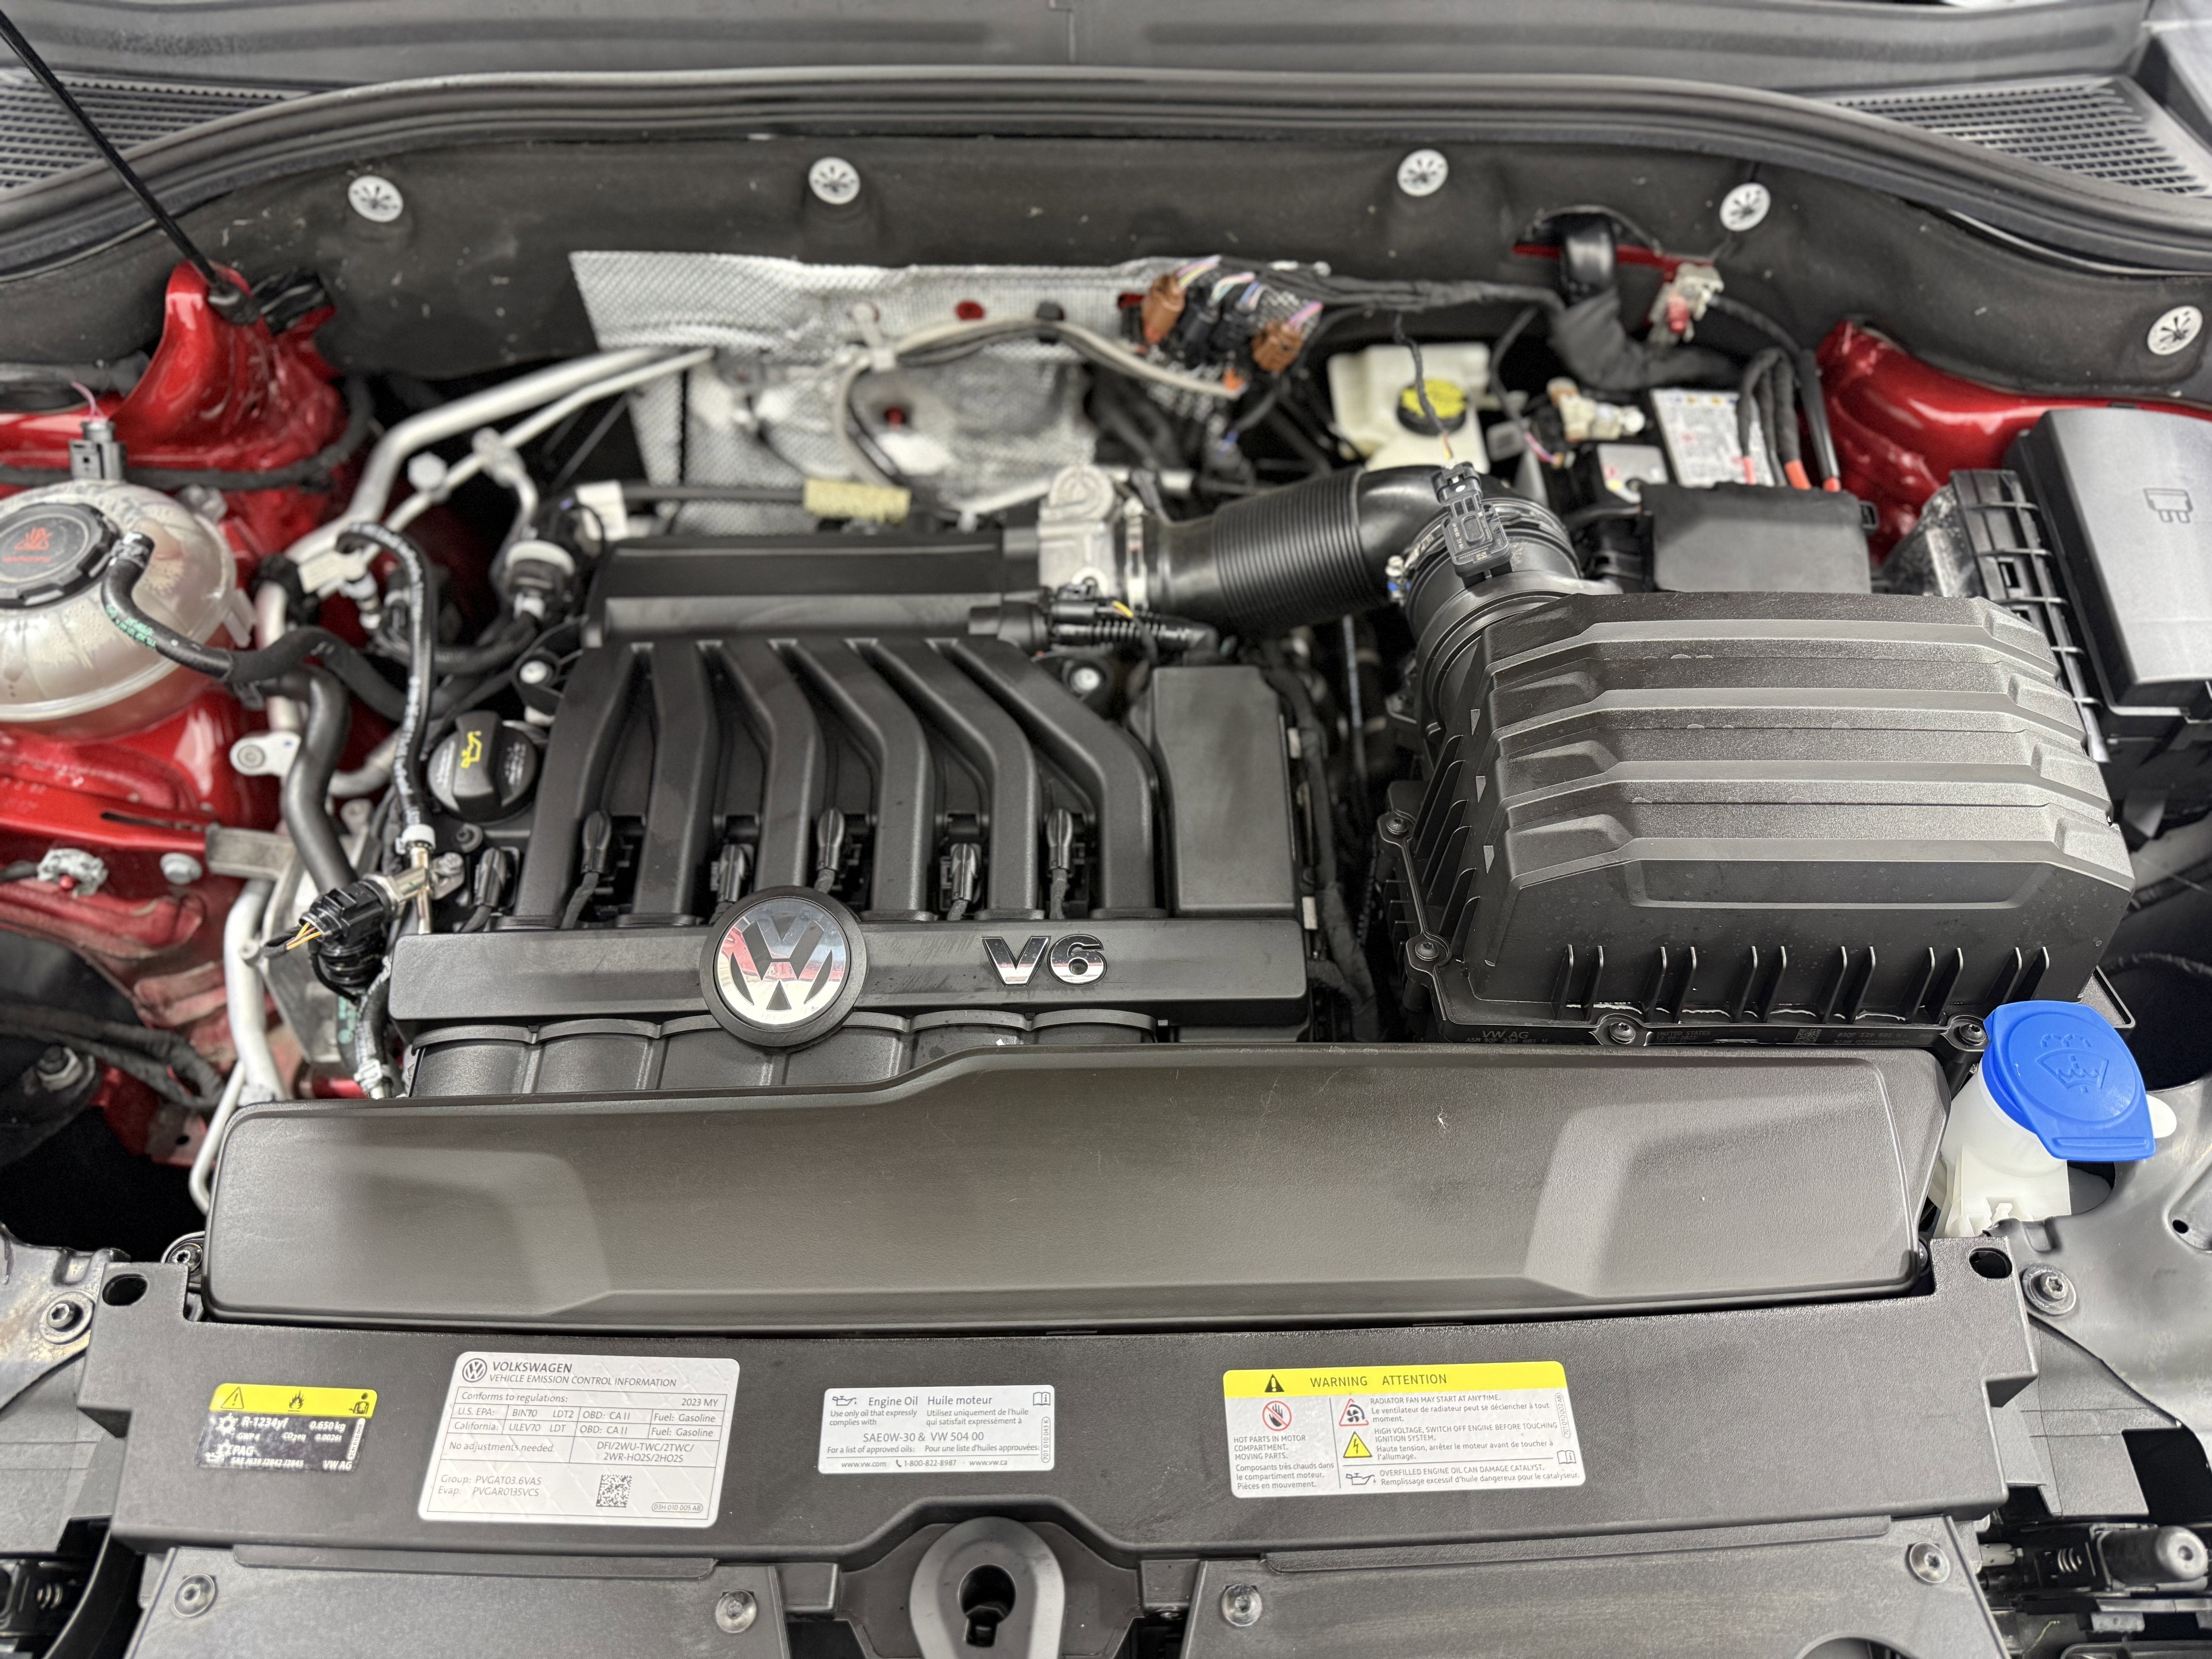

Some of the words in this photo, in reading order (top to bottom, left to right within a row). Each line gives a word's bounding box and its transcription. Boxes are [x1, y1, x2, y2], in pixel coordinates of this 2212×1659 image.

[981, 934, 1108, 988] V6
[493, 1362, 572, 1373] VOLKSWAGEN
[527, 1375, 569, 1383] EMISSION
[572, 1376, 611, 1385] CONTROL
[615, 1377, 676, 1387] INFORMATION
[1310, 1376, 1368, 1387] WARNING
[1382, 1374, 1447, 1385] ATTENTION
[462, 1392, 503, 1401] Conforms
[517, 1393, 568, 1403] regulations:
[869, 1397, 902, 1408] Engine
[905, 1396, 918, 1405] Oil
[927, 1396, 953, 1405] Huile
[512, 1409, 538, 1417] BIN70
[583, 1411, 605, 1419] OBD:
[654, 1413, 674, 1421] Fuel:
[678, 1413, 716, 1422] Gasoline
[845, 1410, 859, 1418] only
[886, 1409, 917, 1417] expressly
[954, 1409, 996, 1417] uniquement
[241, 1416, 289, 1431] R-1234yf
[309, 1421, 334, 1431] 0.650
[335, 1421, 346, 1433] kg
[455, 1422, 498, 1430] California:
[830, 1419, 859, 1427] complies
[926, 1419, 937, 1427] qui
[968, 1417, 1016, 1426] expressément
[509, 1423, 541, 1431] ULEV70
[580, 1425, 602, 1433] OBD:
[651, 1427, 672, 1436] Fuel:
[676, 1428, 713, 1436] Gasoline
[236, 1432, 255, 1441] GWP
[255, 1434, 260, 1442] 4
[918, 1432, 925, 1441] &
[931, 1432, 948, 1441] VW
[950, 1432, 969, 1441] 504
[972, 1432, 984, 1440] 00
[232, 1445, 255, 1456] PAG
[464, 1442, 518, 1452] adjustments
[521, 1444, 555, 1452] needed.
[867, 1446, 899, 1454] approved
[999, 1443, 1040, 1452] approuvées:
[262, 1458, 283, 1467] J2842
[323, 1460, 339, 1470] VW
[338, 1461, 352, 1471] AG
[441, 1475, 471, 1484] Group:
[1245, 1472, 1295, 1481] compartiment
[1381, 1477, 1424, 1486] Remplissage
[1480, 1474, 1516, 1483] dangereux
[1543, 1472, 1580, 1480] catalyseur.
[438, 1486, 462, 1496] Evap:
